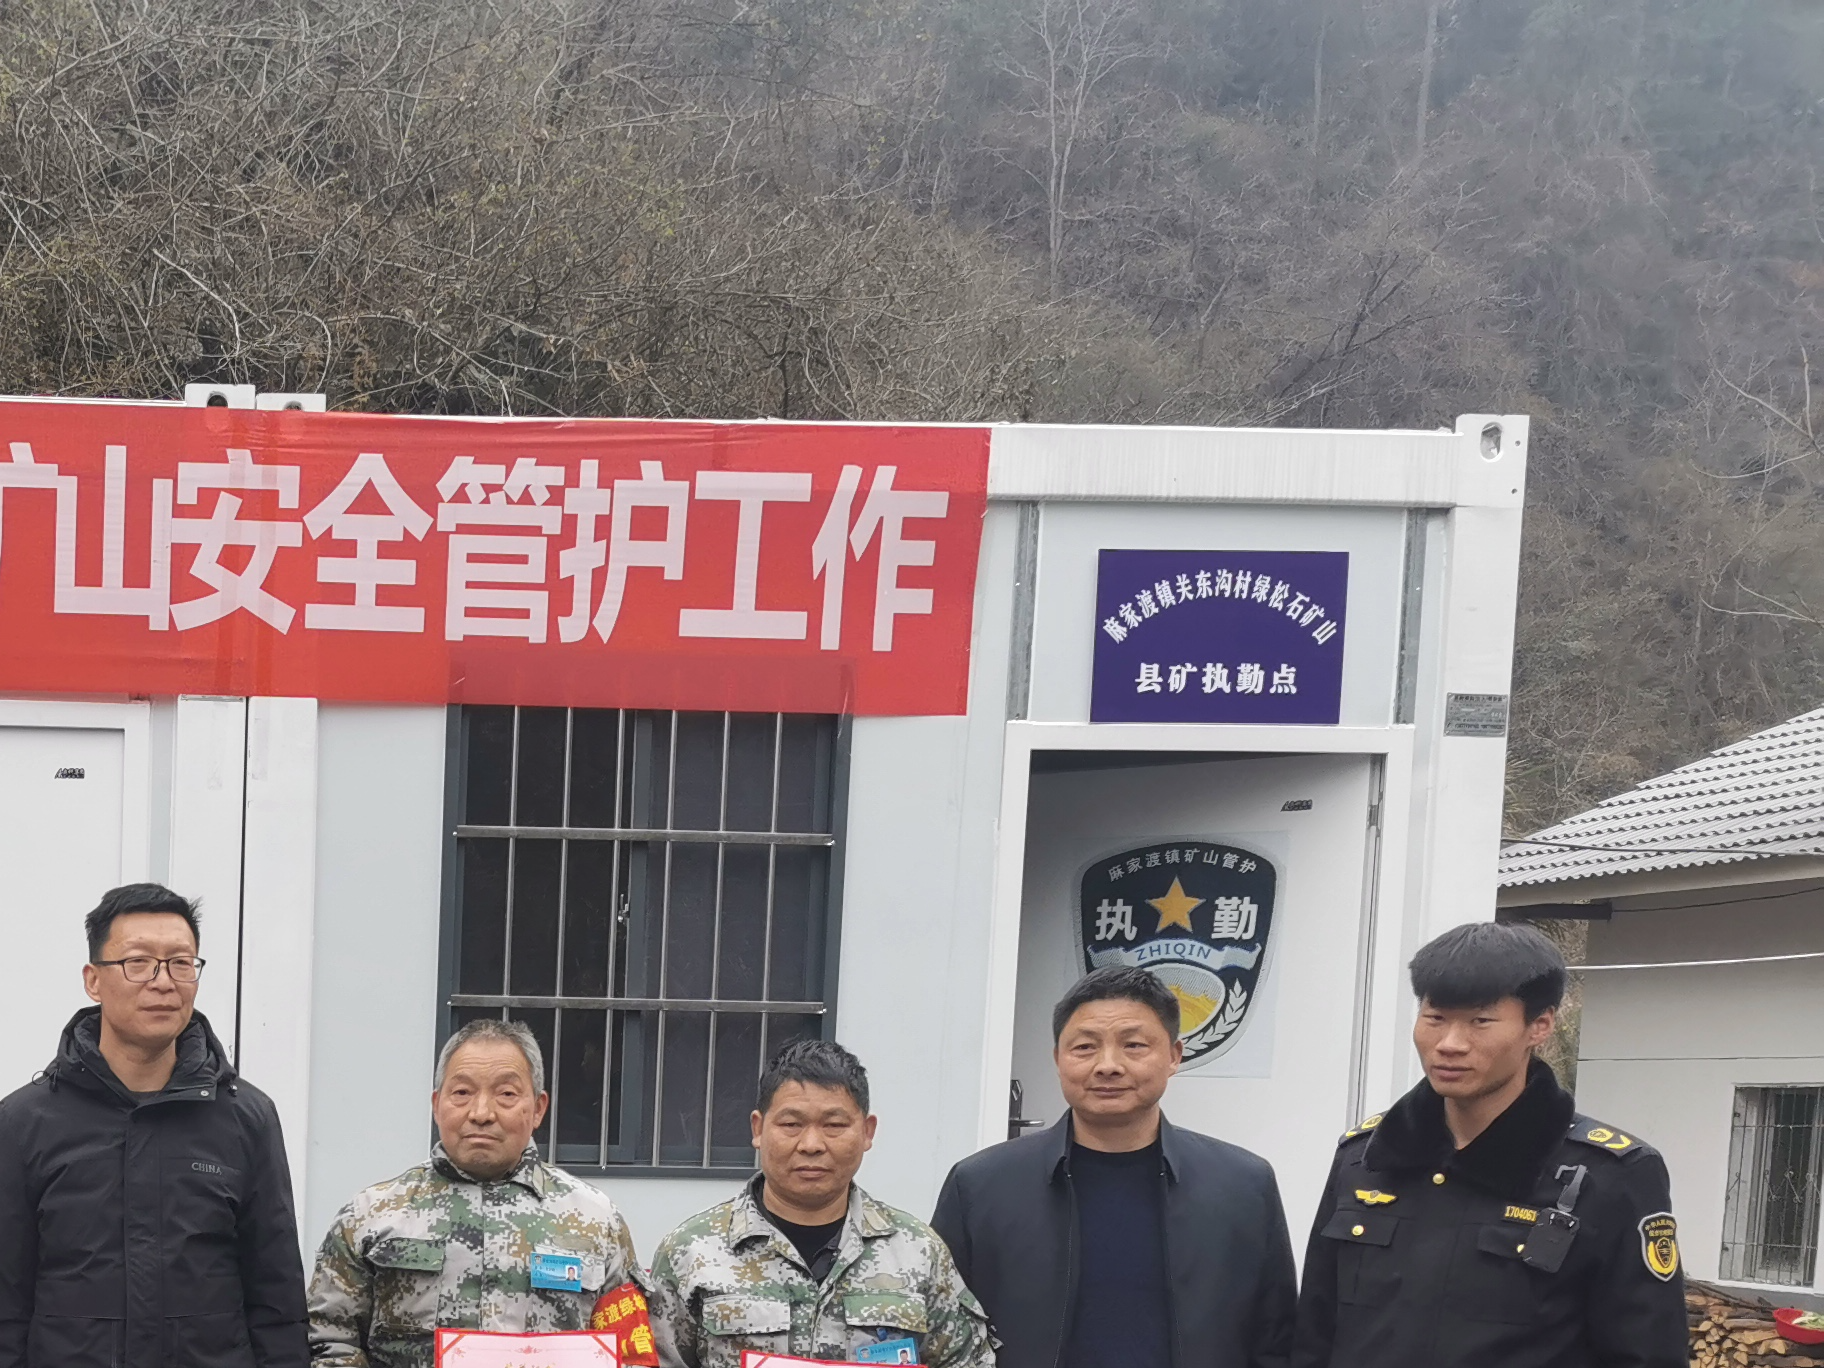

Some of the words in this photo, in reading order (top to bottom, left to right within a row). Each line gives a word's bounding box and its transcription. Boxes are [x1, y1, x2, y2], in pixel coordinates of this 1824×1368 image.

[1102, 569, 1337, 645] 麻家渡镇关东沟村绿松石矿山
[1108, 848, 1257, 882] 麻家渡镇矿山管护
[1134, 942, 1211, 961] ZHIQIN
[191, 1162, 222, 1175] CHINA
